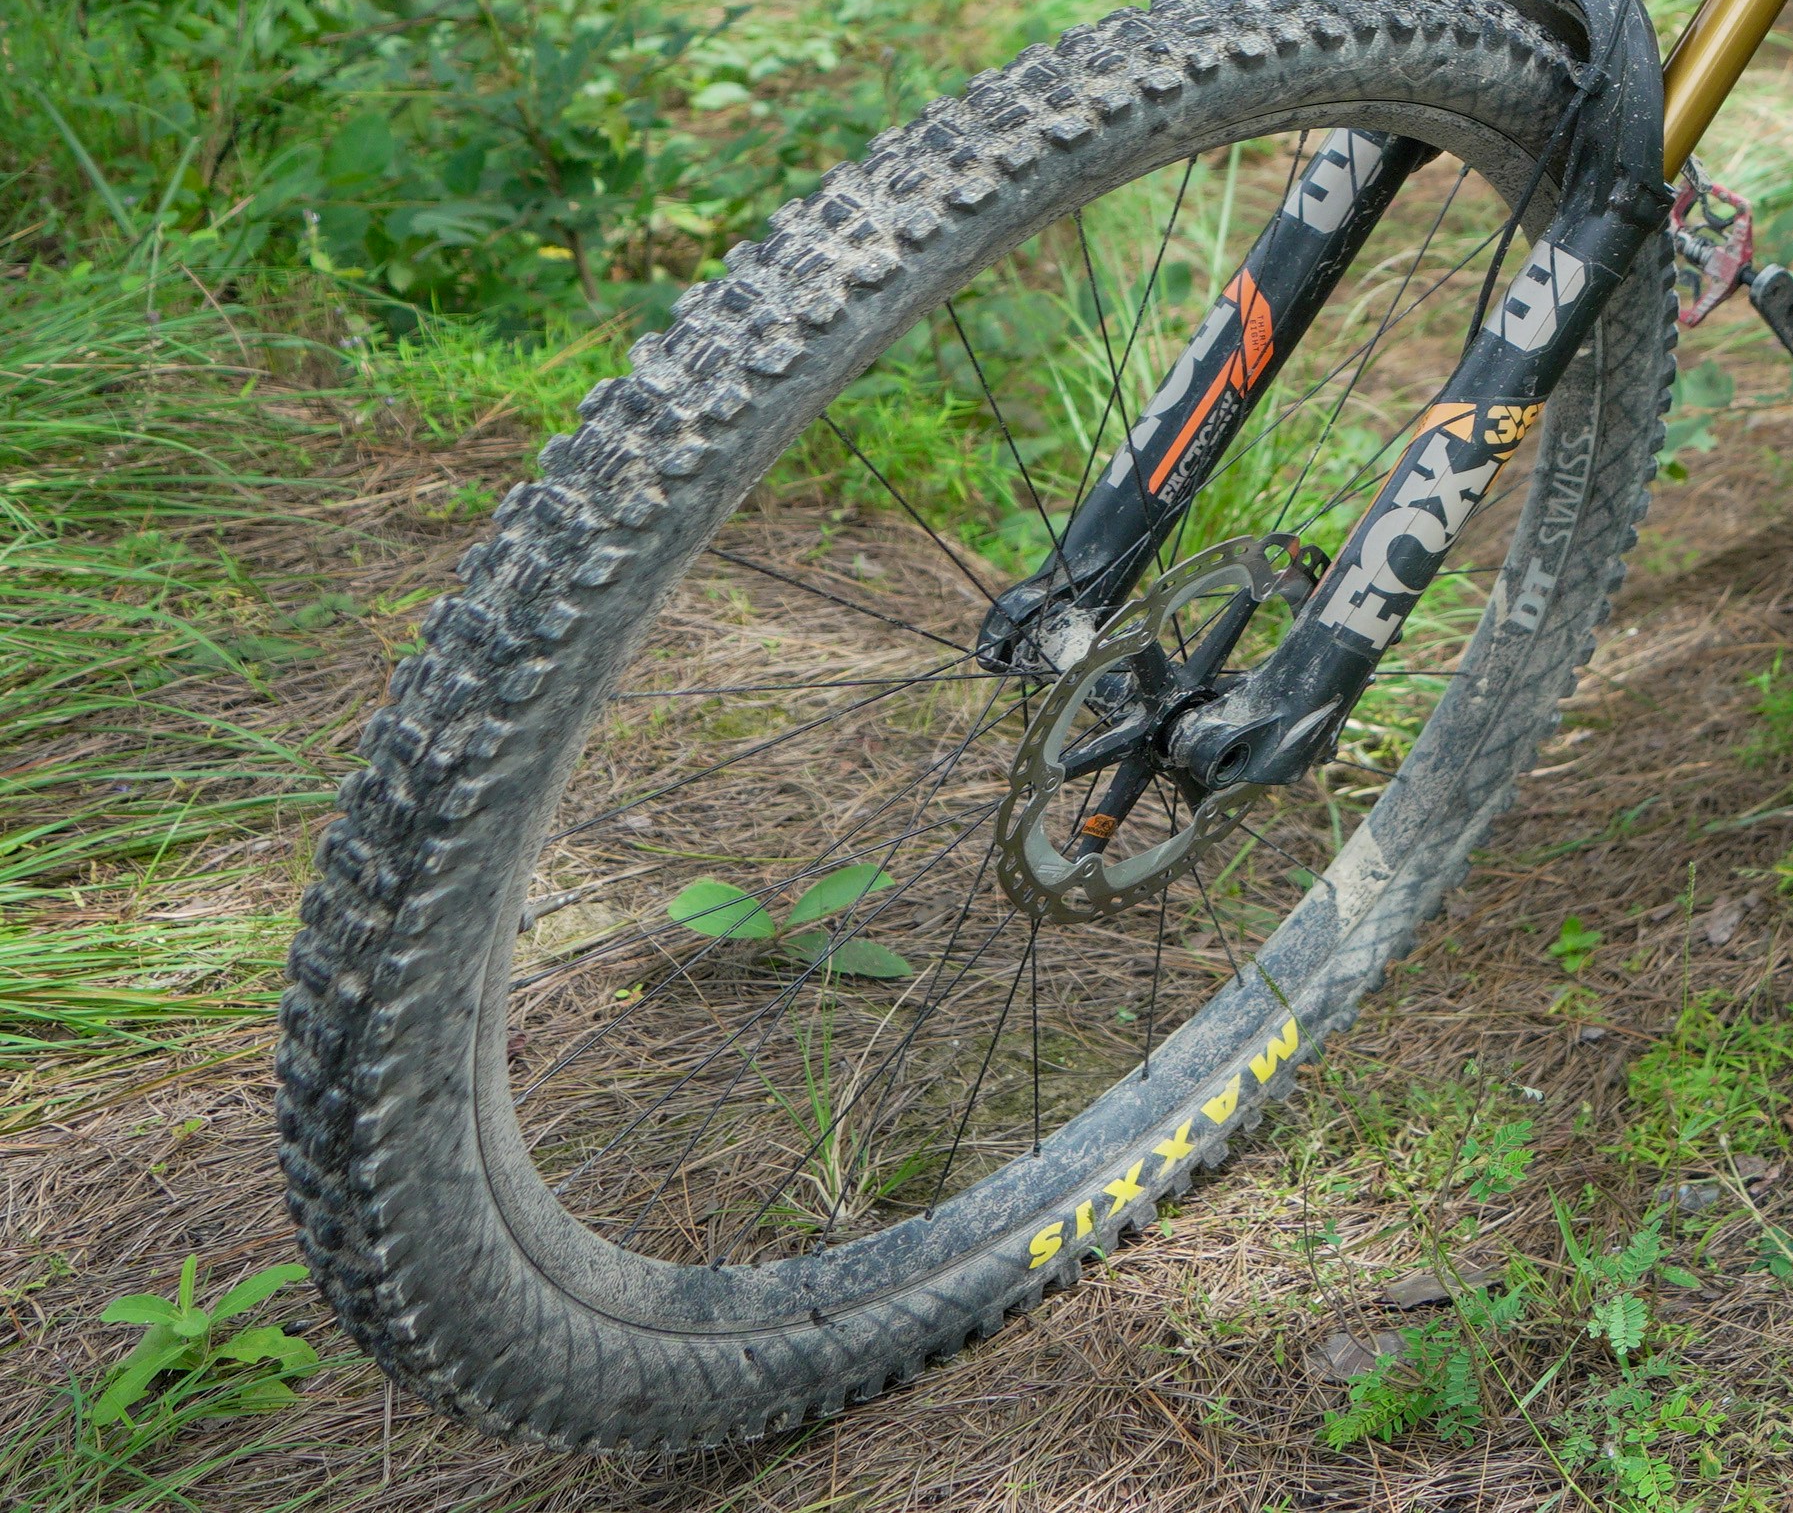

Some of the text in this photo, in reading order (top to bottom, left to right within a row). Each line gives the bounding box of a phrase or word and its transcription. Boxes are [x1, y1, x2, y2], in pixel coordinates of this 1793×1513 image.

[1249, 319, 1260, 352] EIGHT
[1157, 389, 1240, 506] FACTORY
[1318, 431, 1501, 652] FOX
[1506, 424, 1593, 632] DT SWISS
[1028, 1016, 1299, 1270] MAXXIS
